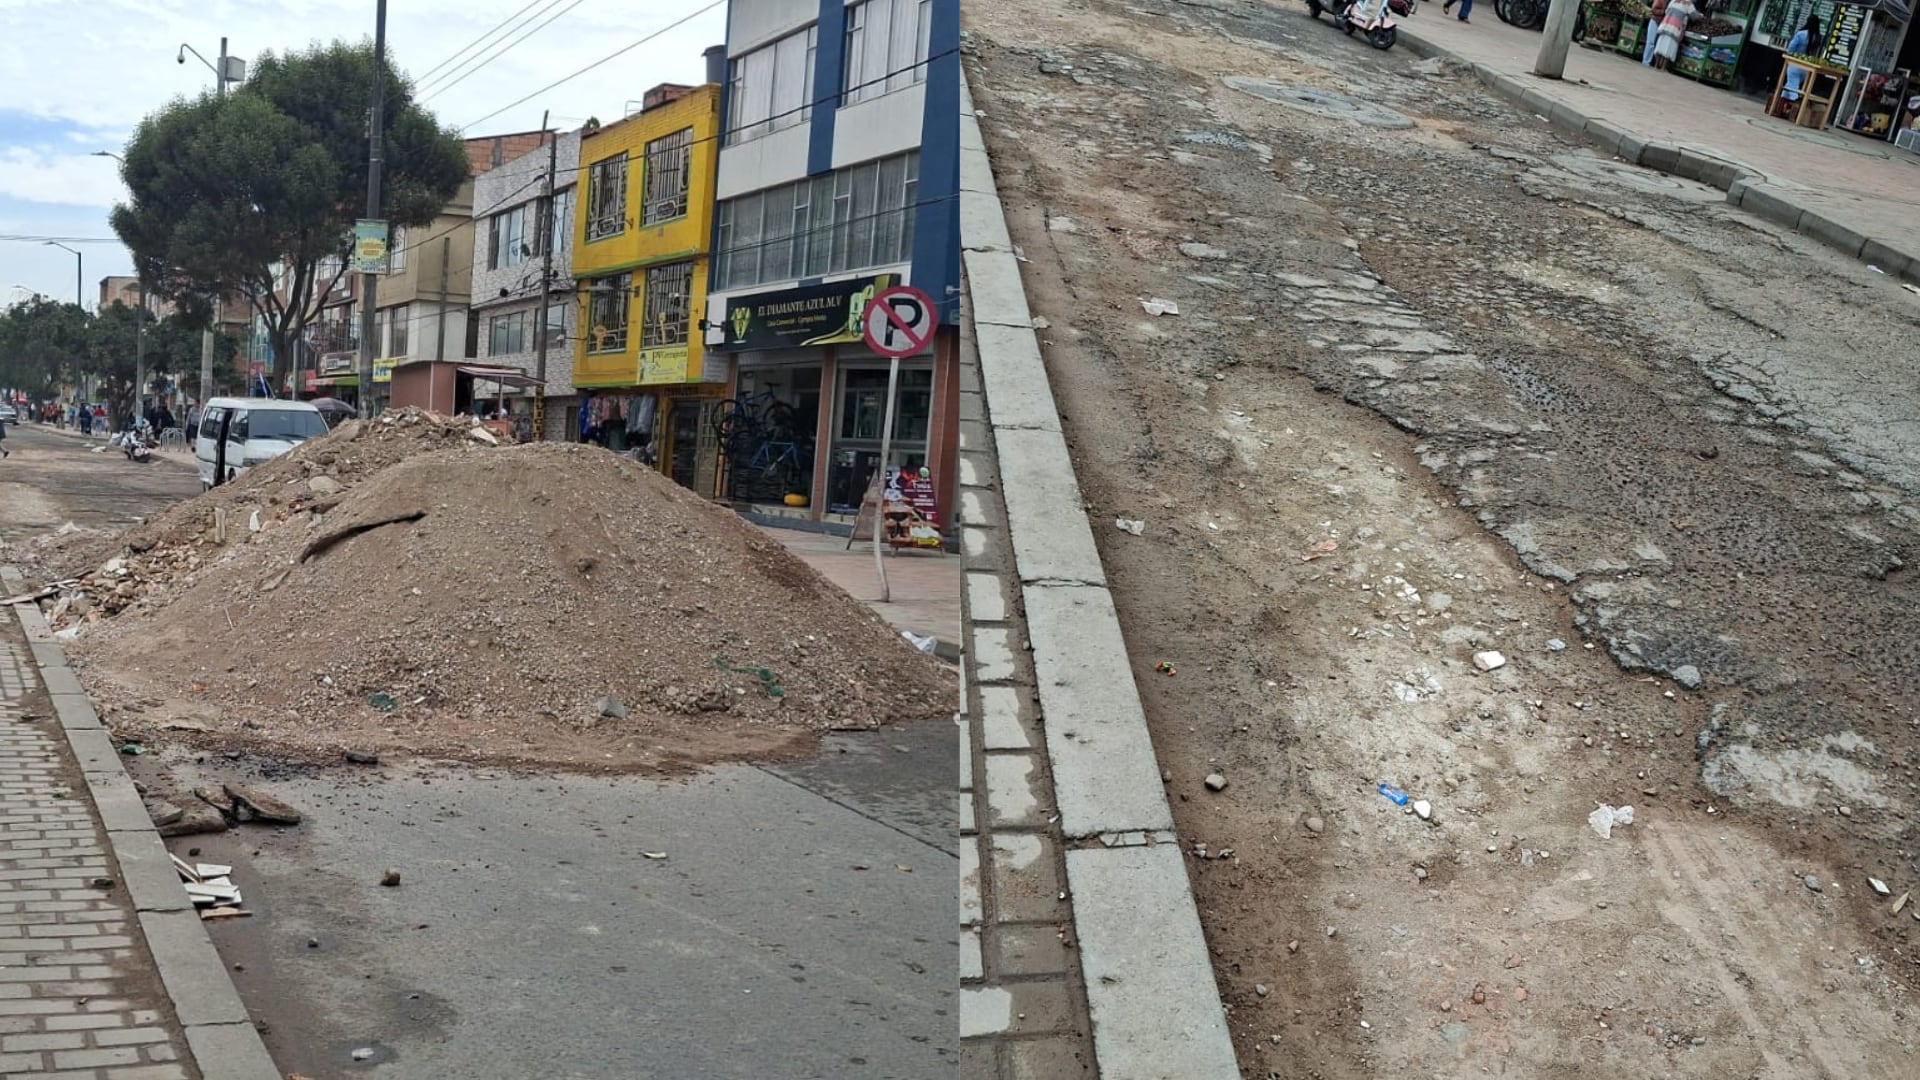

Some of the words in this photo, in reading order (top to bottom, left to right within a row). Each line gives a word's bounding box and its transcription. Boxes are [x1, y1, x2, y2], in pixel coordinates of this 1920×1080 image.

[758, 306, 765, 316] EL
[767, 301, 804, 316] DIAMANTE
[805, 297, 825, 312] AZUL
[884, 298, 923, 347] P
